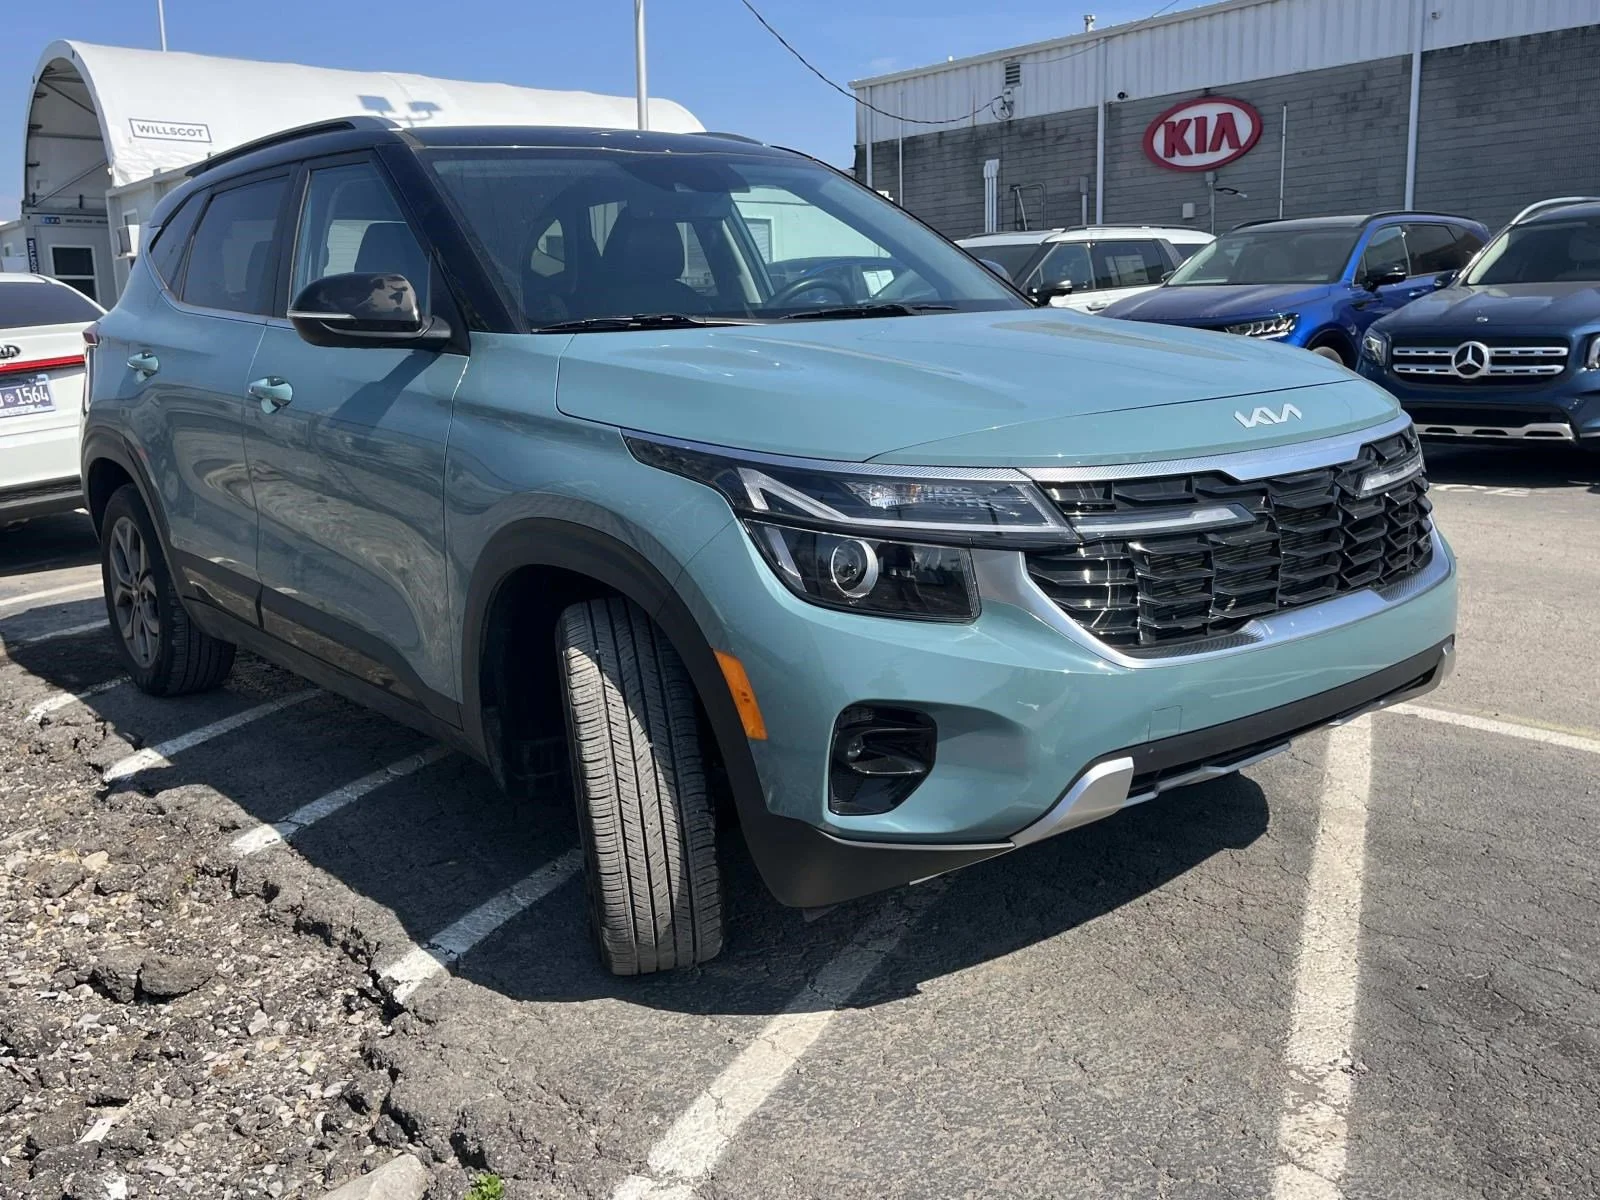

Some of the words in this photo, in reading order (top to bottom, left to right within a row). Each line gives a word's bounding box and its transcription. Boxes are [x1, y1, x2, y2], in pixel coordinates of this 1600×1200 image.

[137, 124, 204, 137] WILLSCOT
[1163, 112, 1241, 158] KIA
[28, 240, 38, 273] WILLSCO
[16, 386, 49, 405] 1564
[1234, 403, 1302, 428] KIA
